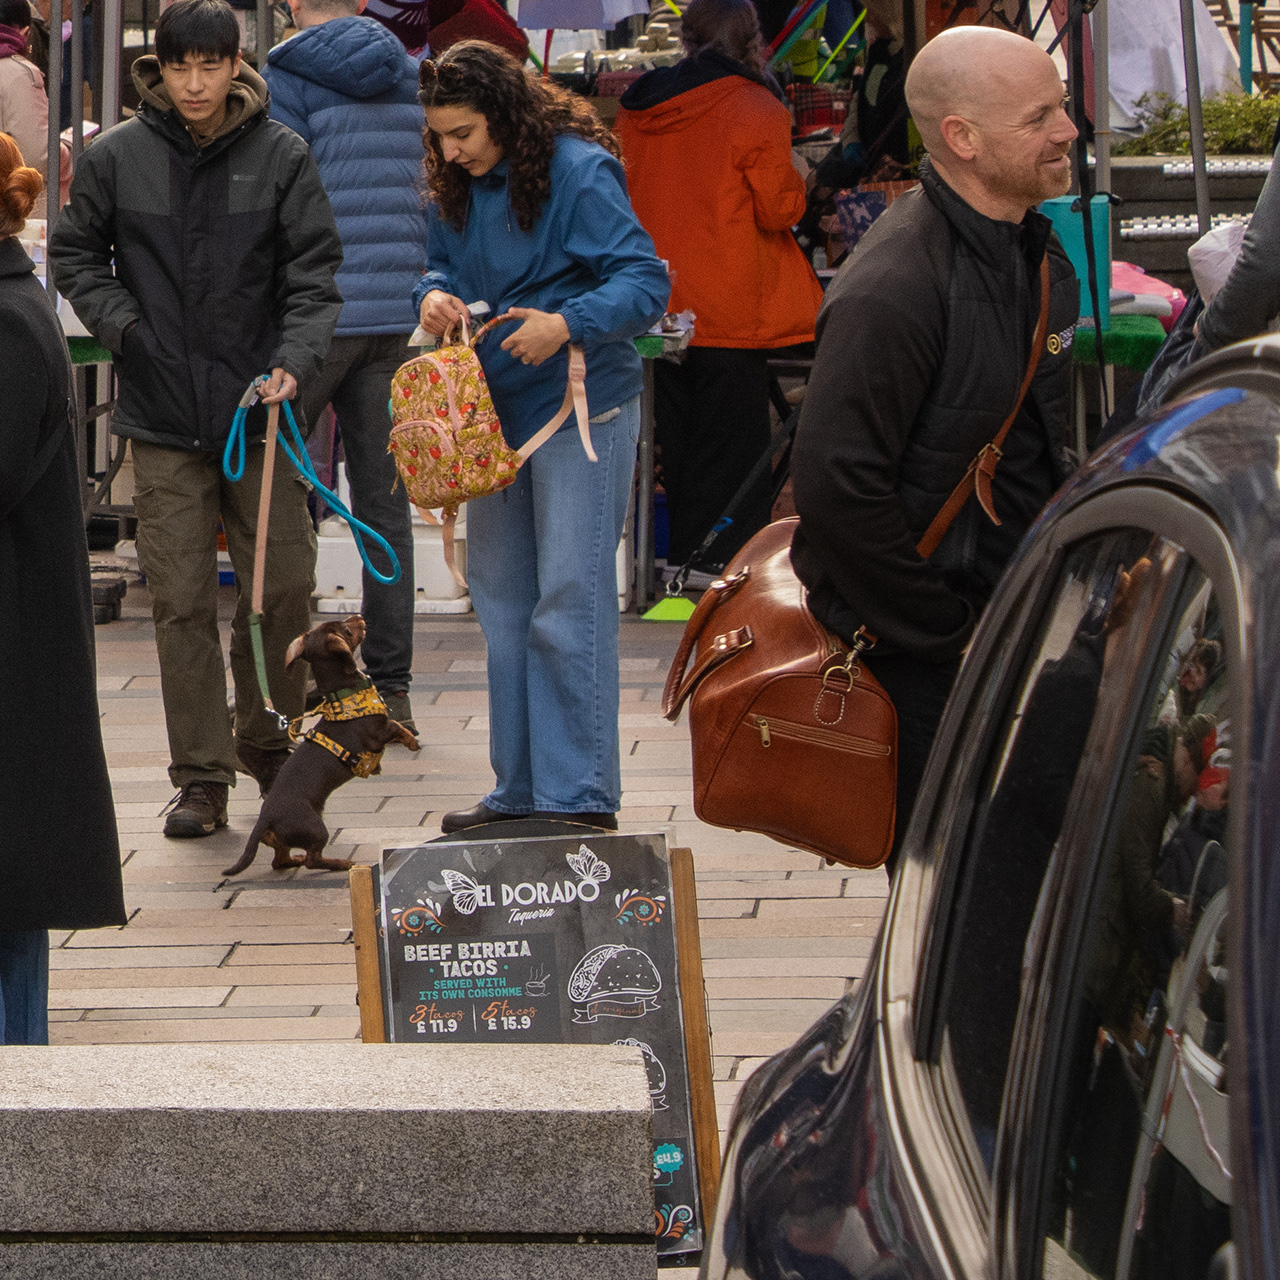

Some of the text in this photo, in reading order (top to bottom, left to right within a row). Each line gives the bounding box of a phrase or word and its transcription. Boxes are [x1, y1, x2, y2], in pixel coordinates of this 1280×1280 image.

[477, 879, 600, 907] EL DORADO
[508, 907, 556, 926] Taqueria
[404, 940, 532, 962] BEEF BIRRIA
[440, 960, 498, 978] TACOS
[433, 977, 507, 990] SERVED WITH
[419, 987, 523, 1001] ITS OWN CONSOMME
[430, 1019, 458, 1033] 11.9
[501, 1016, 532, 1030] 15.9
